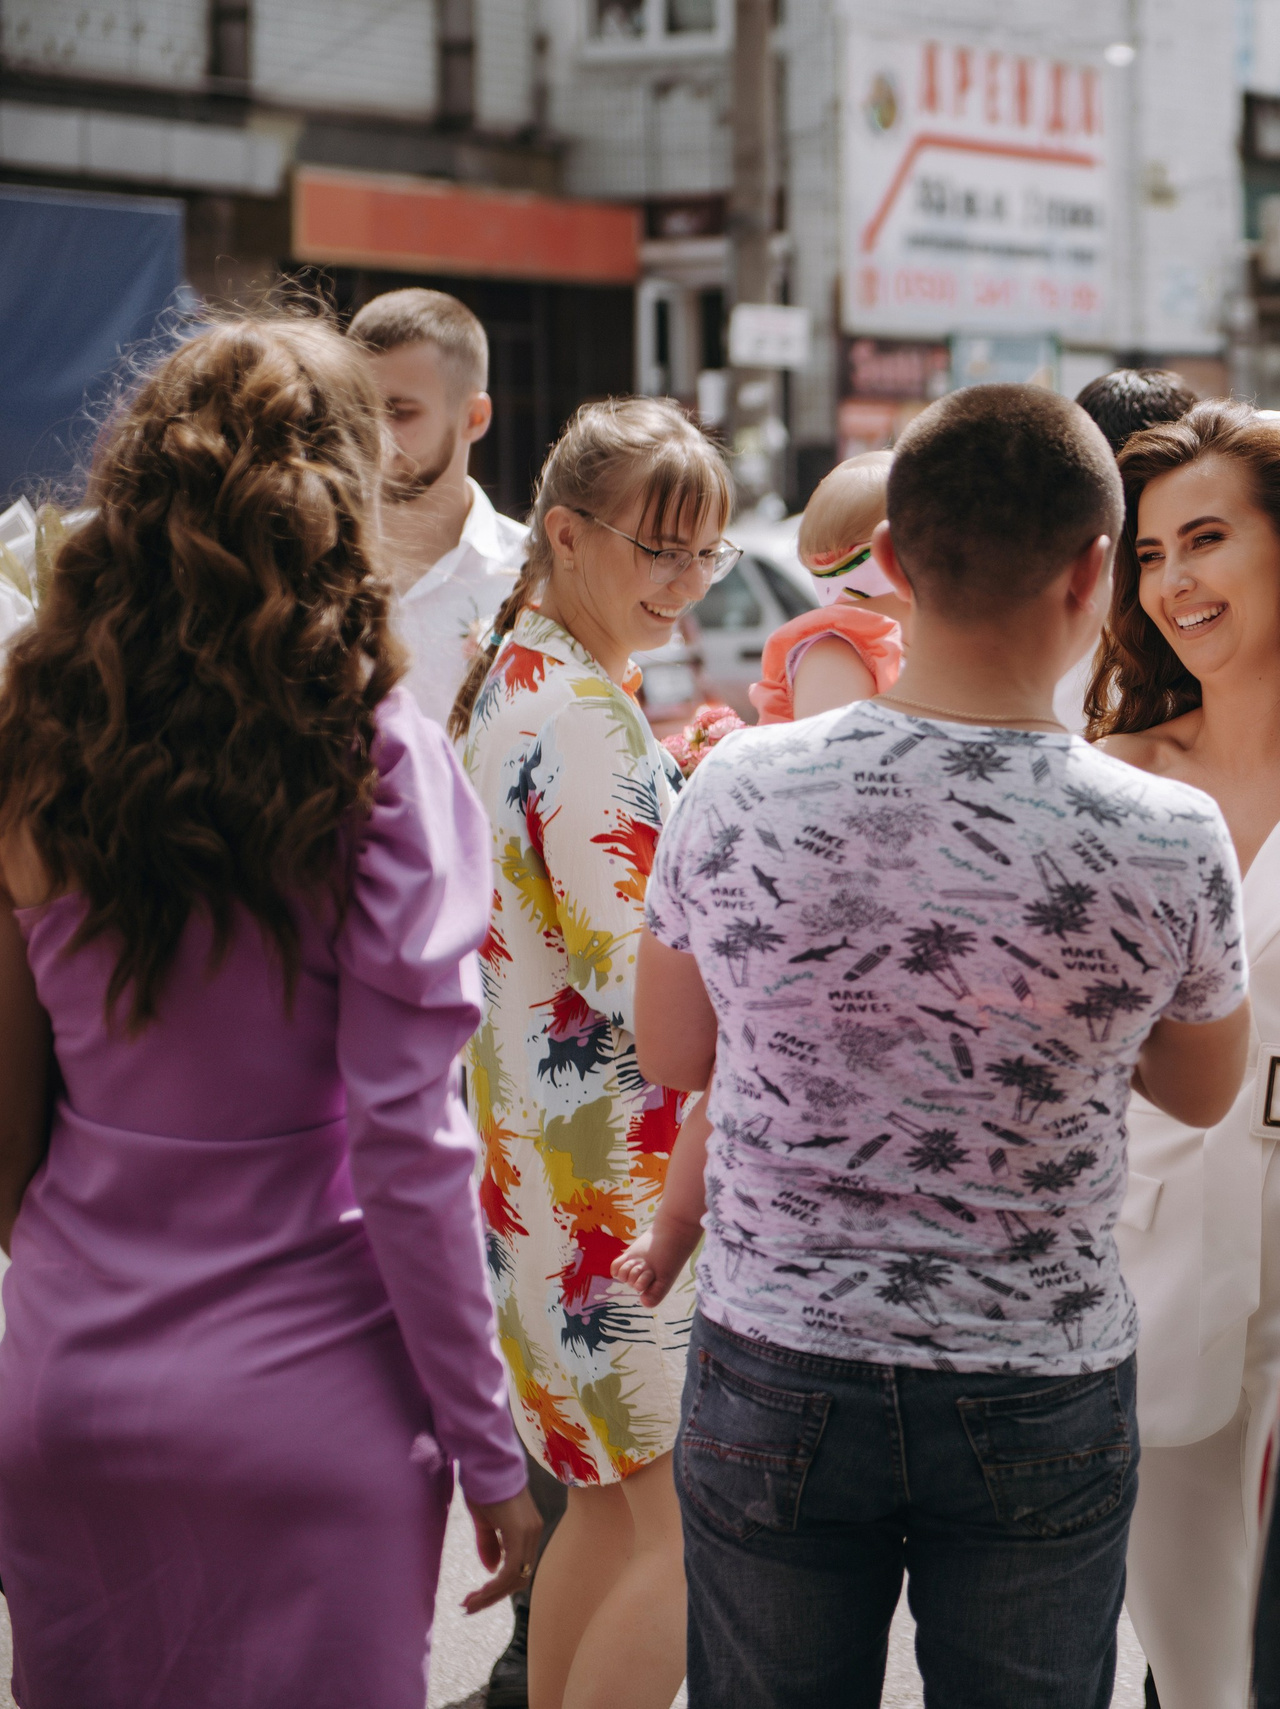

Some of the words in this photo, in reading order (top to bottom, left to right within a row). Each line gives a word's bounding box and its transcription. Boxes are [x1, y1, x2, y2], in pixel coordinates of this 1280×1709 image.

[854, 771, 902, 783] MAKE
[855, 787, 912, 798] WAVES
[802, 825, 848, 850] MAKE
[793, 837, 847, 865] WAVES
[710, 887, 748, 898] MAKE
[714, 900, 755, 911] WAVES
[1061, 947, 1107, 960] MAKE
[1064, 962, 1119, 975] WAVES
[828, 990, 879, 1001] MAKE
[832, 1003, 892, 1014] WAVES
[773, 1031, 819, 1051] MAKE
[768, 1042, 820, 1066] WAVES
[778, 1190, 821, 1213] MAKE
[771, 1200, 821, 1226] WAVES
[1029, 1261, 1071, 1278] MAKE
[1035, 1271, 1082, 1289] WAVES
[803, 1306, 847, 1322] MAKE
